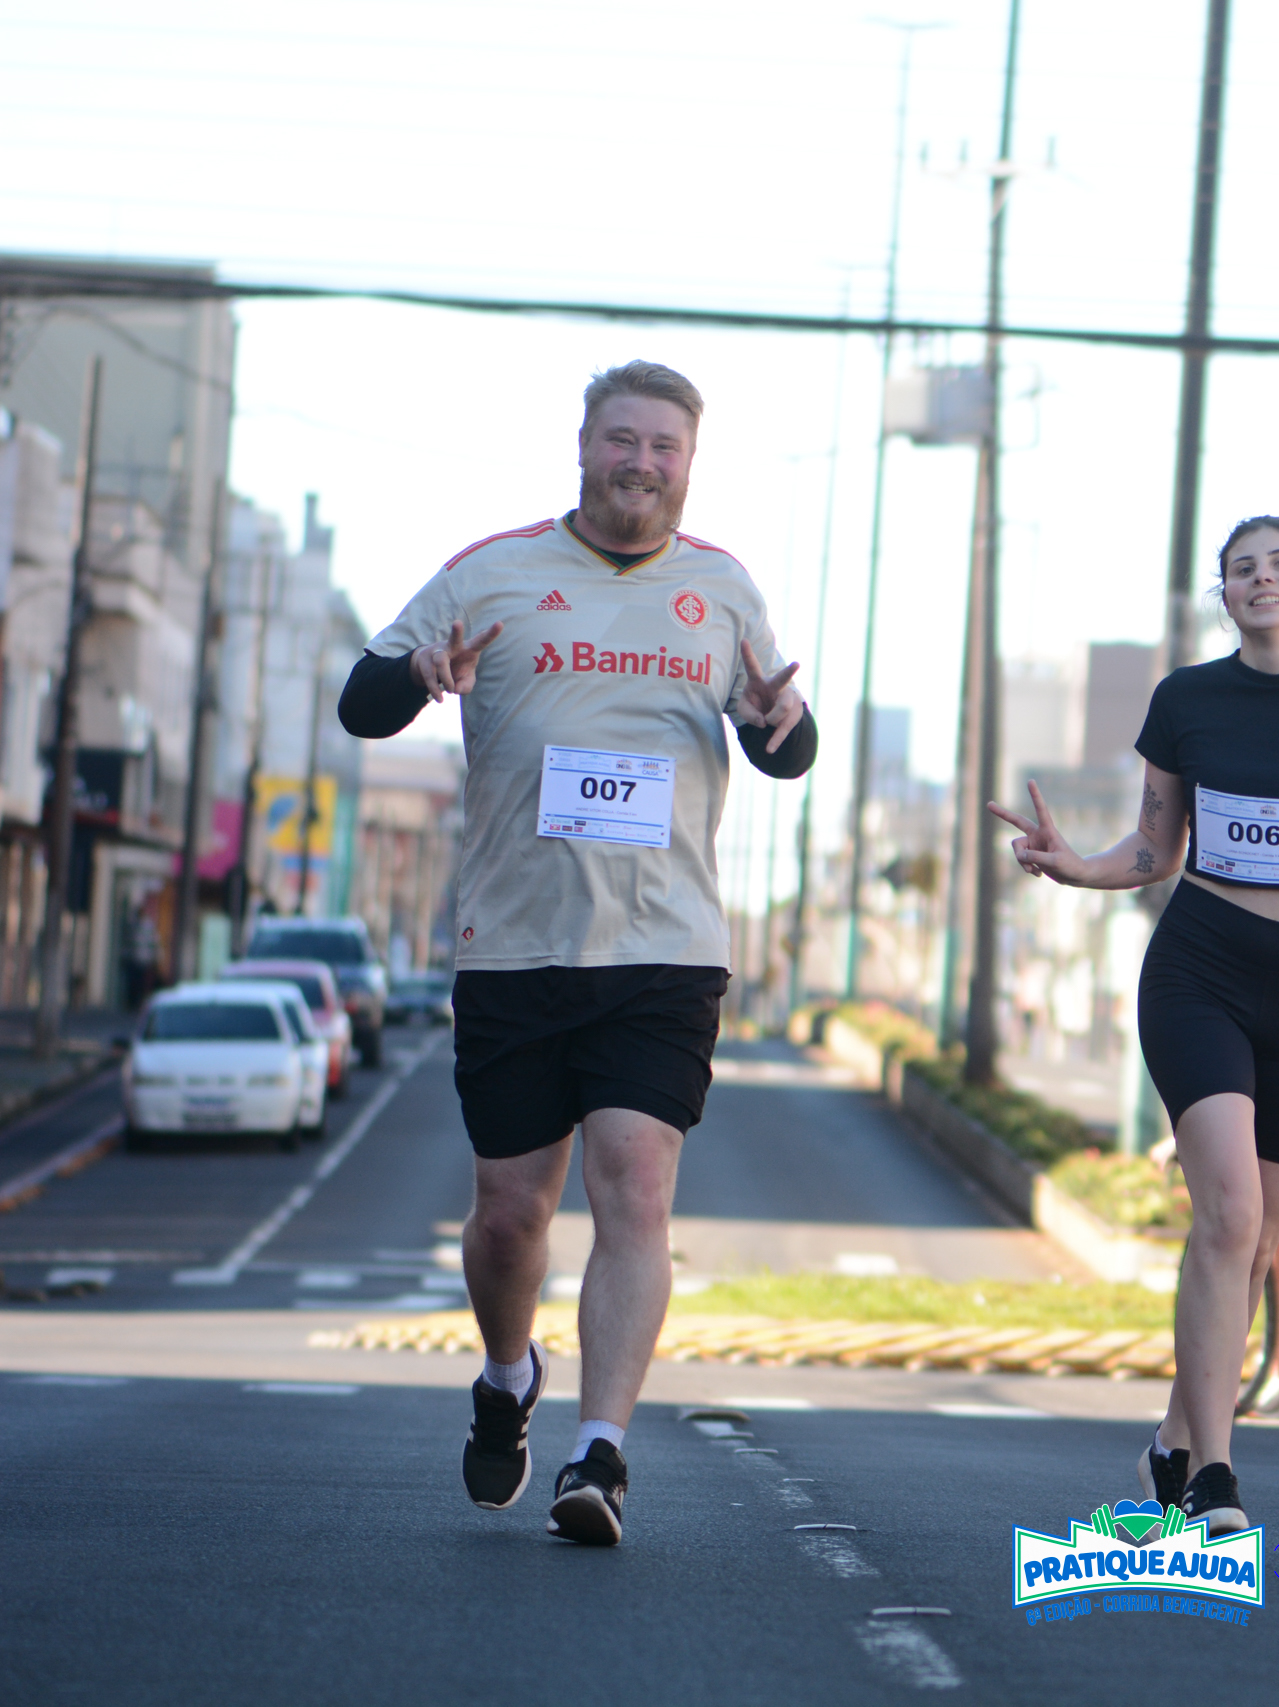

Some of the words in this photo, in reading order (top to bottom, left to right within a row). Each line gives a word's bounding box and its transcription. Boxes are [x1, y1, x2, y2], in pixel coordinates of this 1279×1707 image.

[536, 602, 572, 611] adidas
[572, 641, 712, 686] Banrisul
[580, 777, 637, 802] 007
